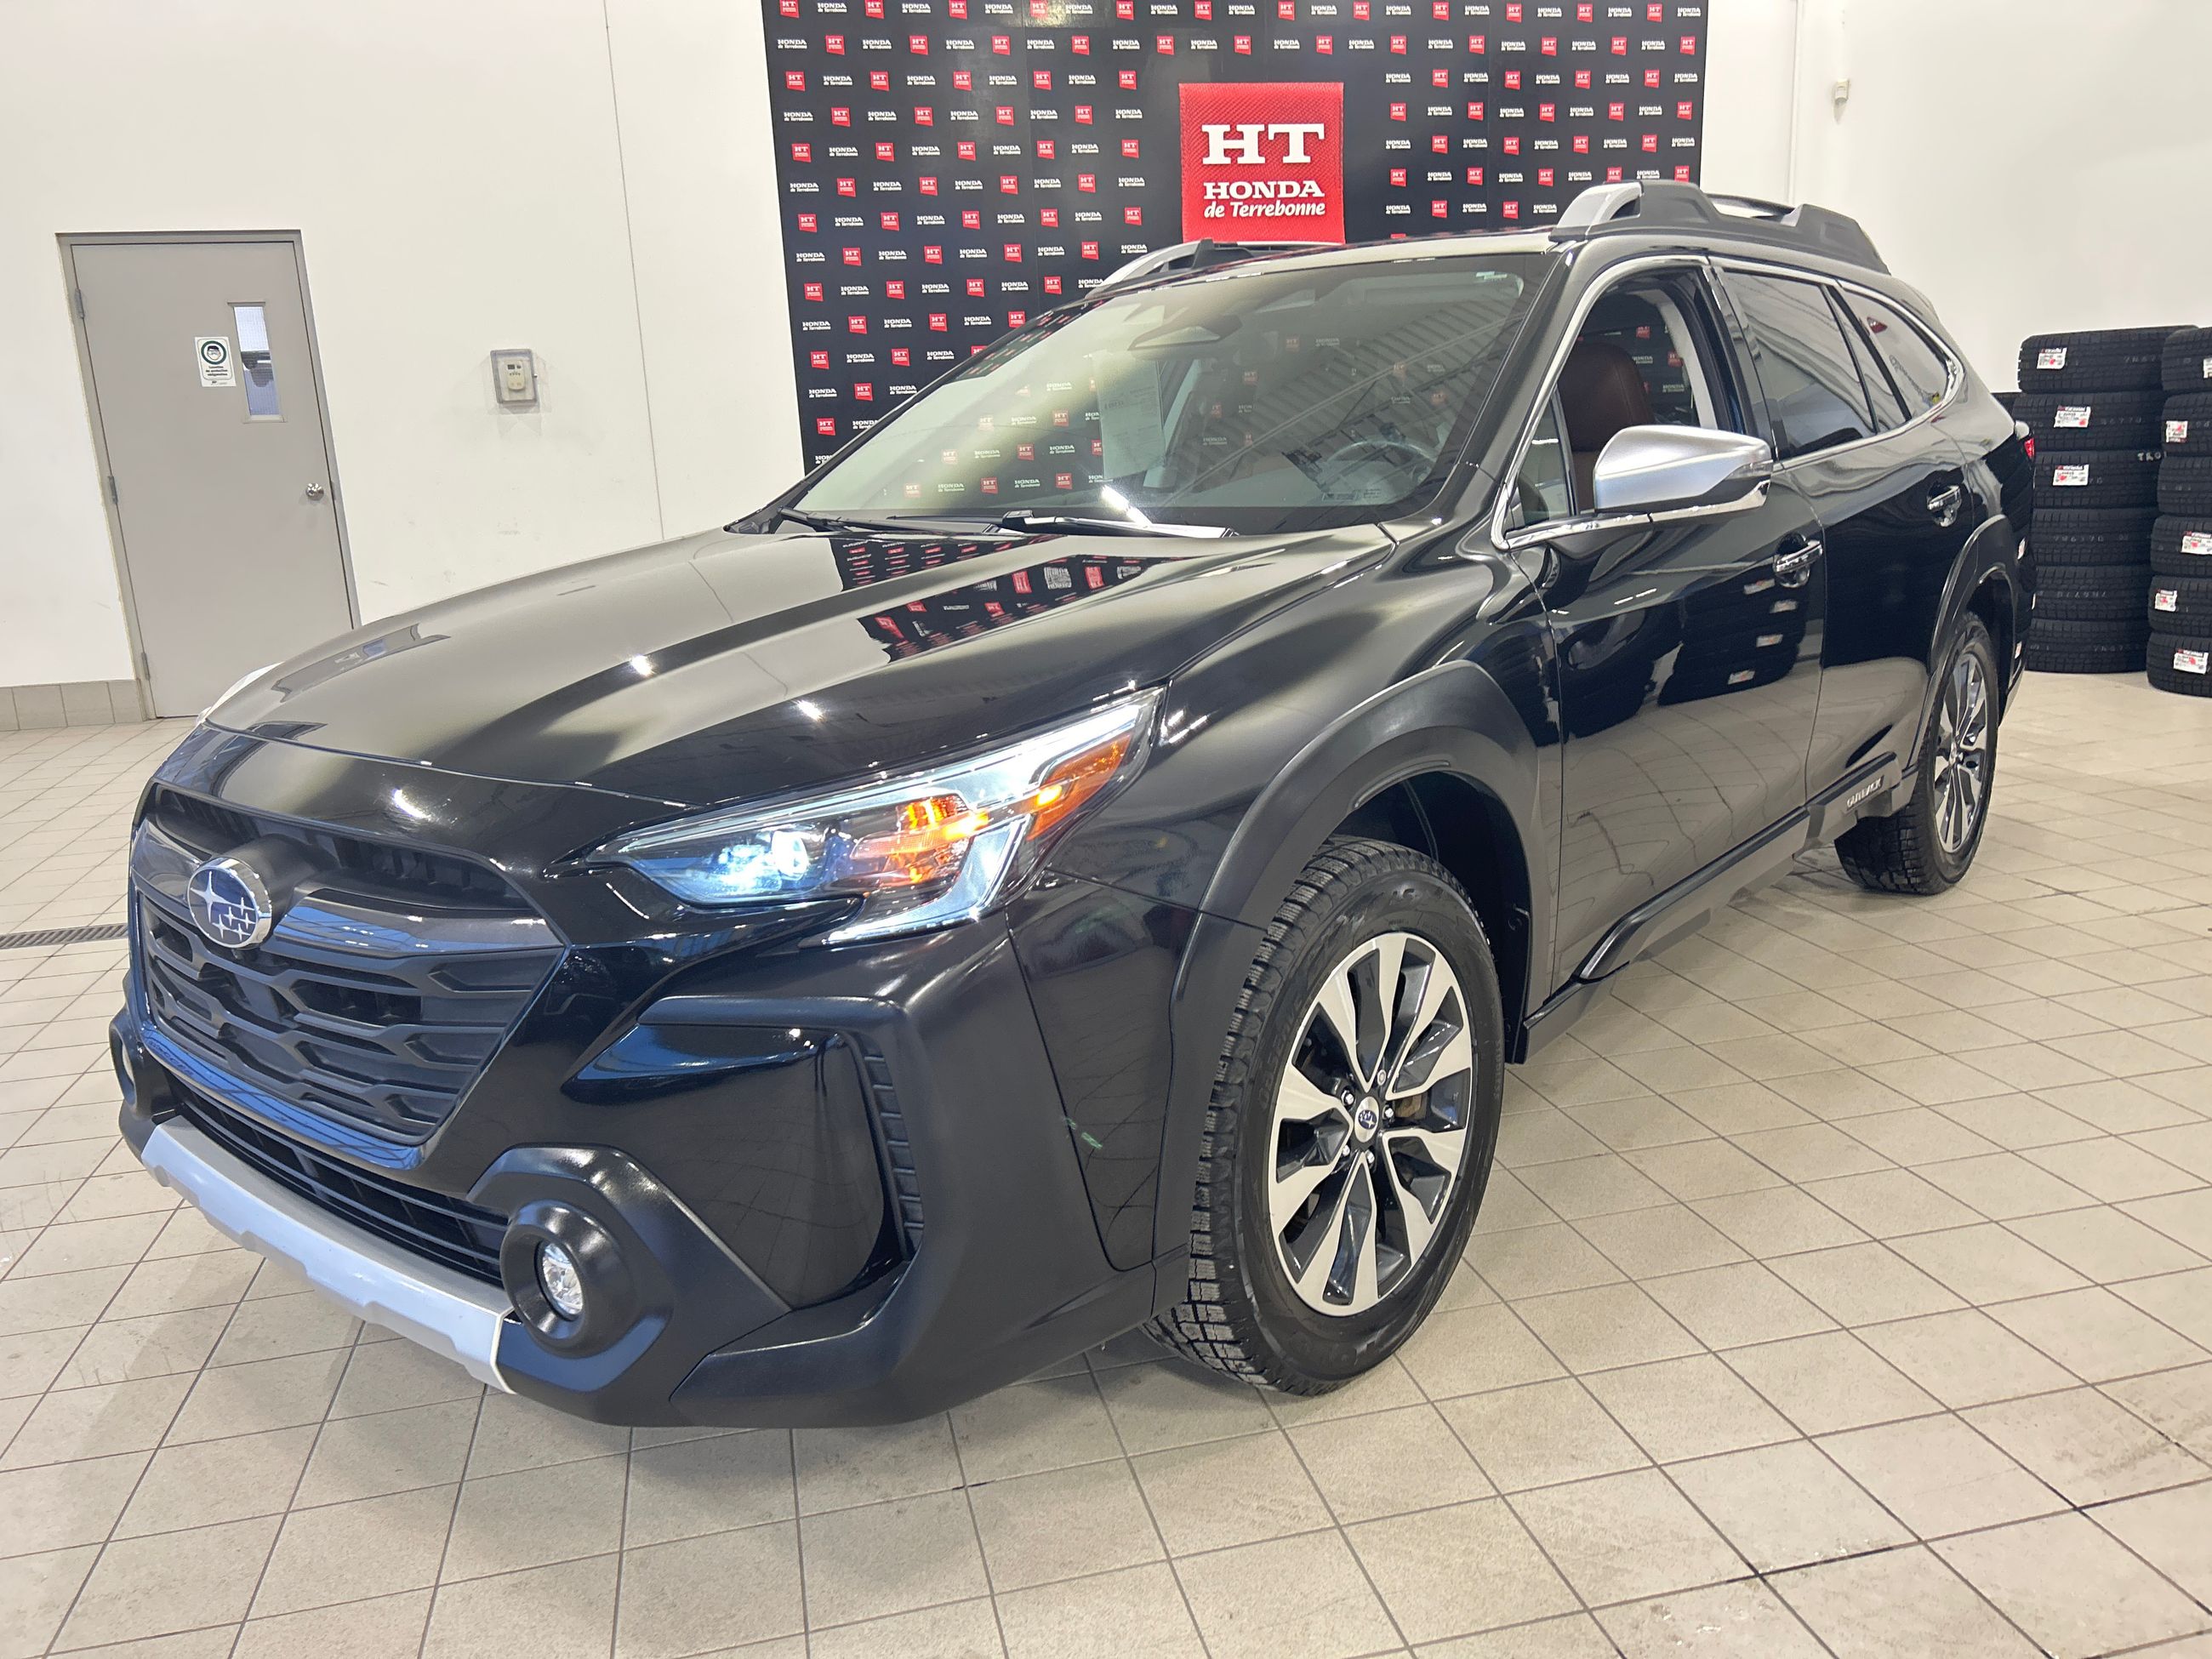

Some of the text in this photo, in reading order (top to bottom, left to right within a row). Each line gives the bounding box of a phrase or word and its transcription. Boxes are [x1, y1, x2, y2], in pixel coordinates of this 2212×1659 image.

[1201, 123, 1325, 164] HT
[1204, 180, 1325, 199] HONDA
[1204, 200, 1325, 219] de Terrebonne
